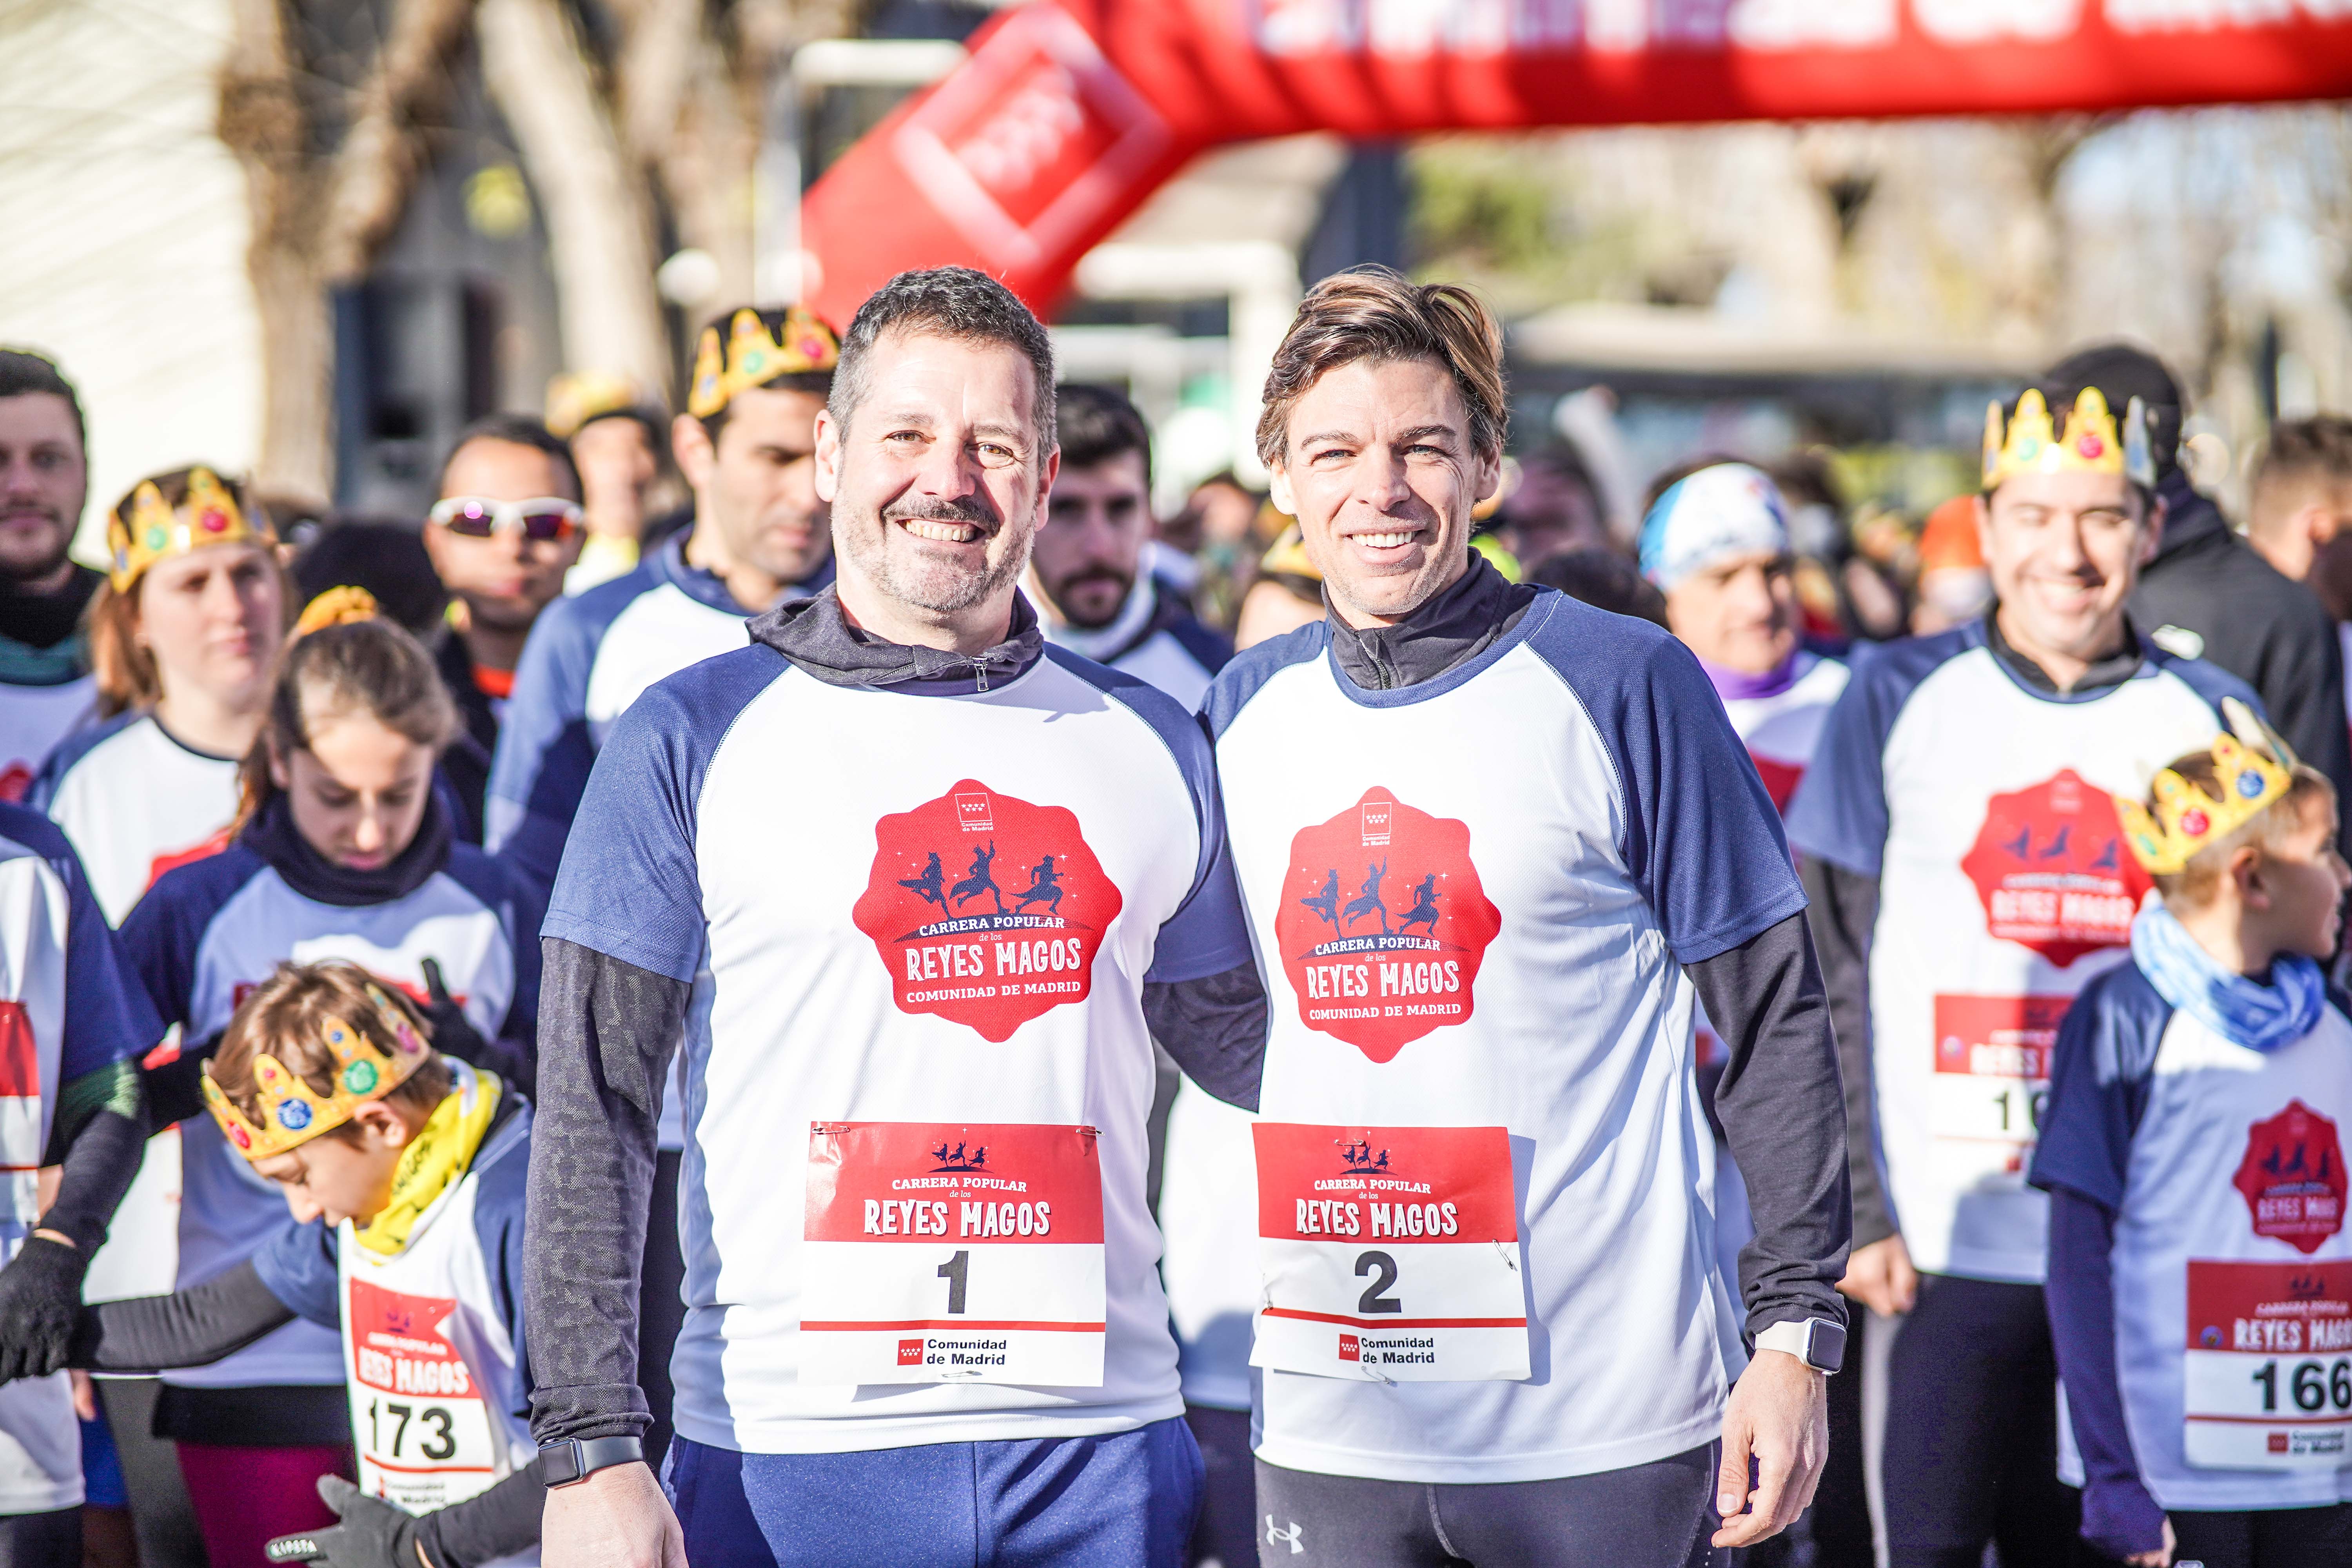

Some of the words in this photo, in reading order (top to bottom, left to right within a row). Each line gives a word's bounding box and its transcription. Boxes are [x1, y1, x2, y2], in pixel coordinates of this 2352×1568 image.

[919, 918, 989, 936] CARRERA
[994, 916, 1065, 929] POPULAR
[991, 933, 1002, 941] los
[1315, 938, 1375, 955] CARRERA
[1379, 937, 1441, 951] POPULAR
[905, 944, 984, 982] REYES
[995, 938, 1082, 976] MAGOS
[1306, 964, 1369, 1000] REYES
[1379, 960, 1460, 997] MAGOS
[907, 987, 995, 1003] COMUNIDAD
[1002, 985, 1020, 996] DE
[1024, 981, 1081, 994] MADRID
[1309, 1008, 1379, 1020] COMUNIDAD
[1385, 1006, 1403, 1016] DE
[1407, 1004, 1461, 1015] MADRID
[892, 1177, 959, 1191] CARRERA
[963, 1177, 1027, 1193] POPULAR
[1314, 1179, 1367, 1191] CARRERA
[1370, 1180, 1431, 1194] POPULAR
[1359, 1191, 1367, 1200] de
[863, 1199, 949, 1237] REYES
[960, 1201, 1051, 1238] MAGOS
[1296, 1198, 1361, 1237] REYES
[1370, 1202, 1459, 1239] MAGOS
[938, 1250, 969, 1314] 1
[1355, 1250, 1402, 1314] 2
[927, 1339, 1007, 1350] Comunidad
[1361, 1337, 1434, 1348] Comunidad
[927, 1354, 945, 1365] de
[952, 1353, 1005, 1366] Madrid
[1363, 1352, 1377, 1364] de
[1383, 1352, 1435, 1363] Madrid
[2252, 1359, 2352, 1411] 166
[369, 1398, 456, 1459] 173
